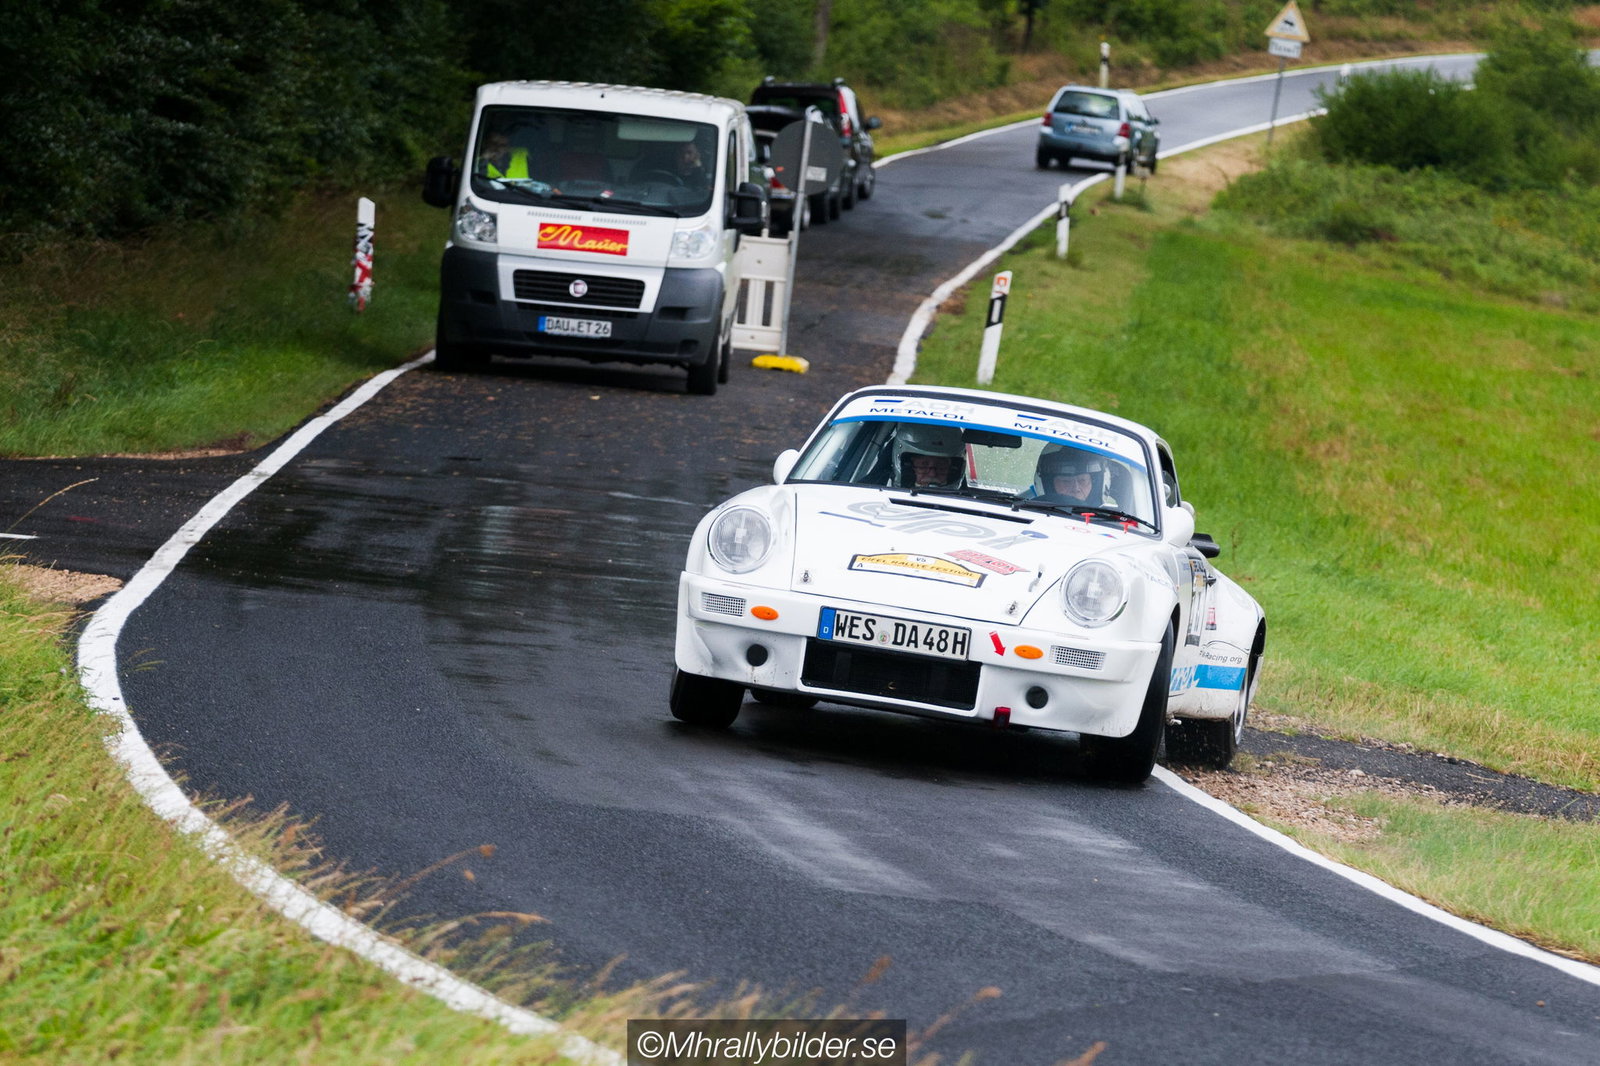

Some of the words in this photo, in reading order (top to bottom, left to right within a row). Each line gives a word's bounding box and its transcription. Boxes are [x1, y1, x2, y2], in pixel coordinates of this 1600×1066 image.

[546, 317, 570, 331] DAU
[870, 408, 971, 421] METACOL
[1014, 422, 1116, 450] METACOL
[891, 560, 927, 569] RALLYE
[930, 566, 975, 577] FESTIVAL
[835, 613, 877, 641] WES
